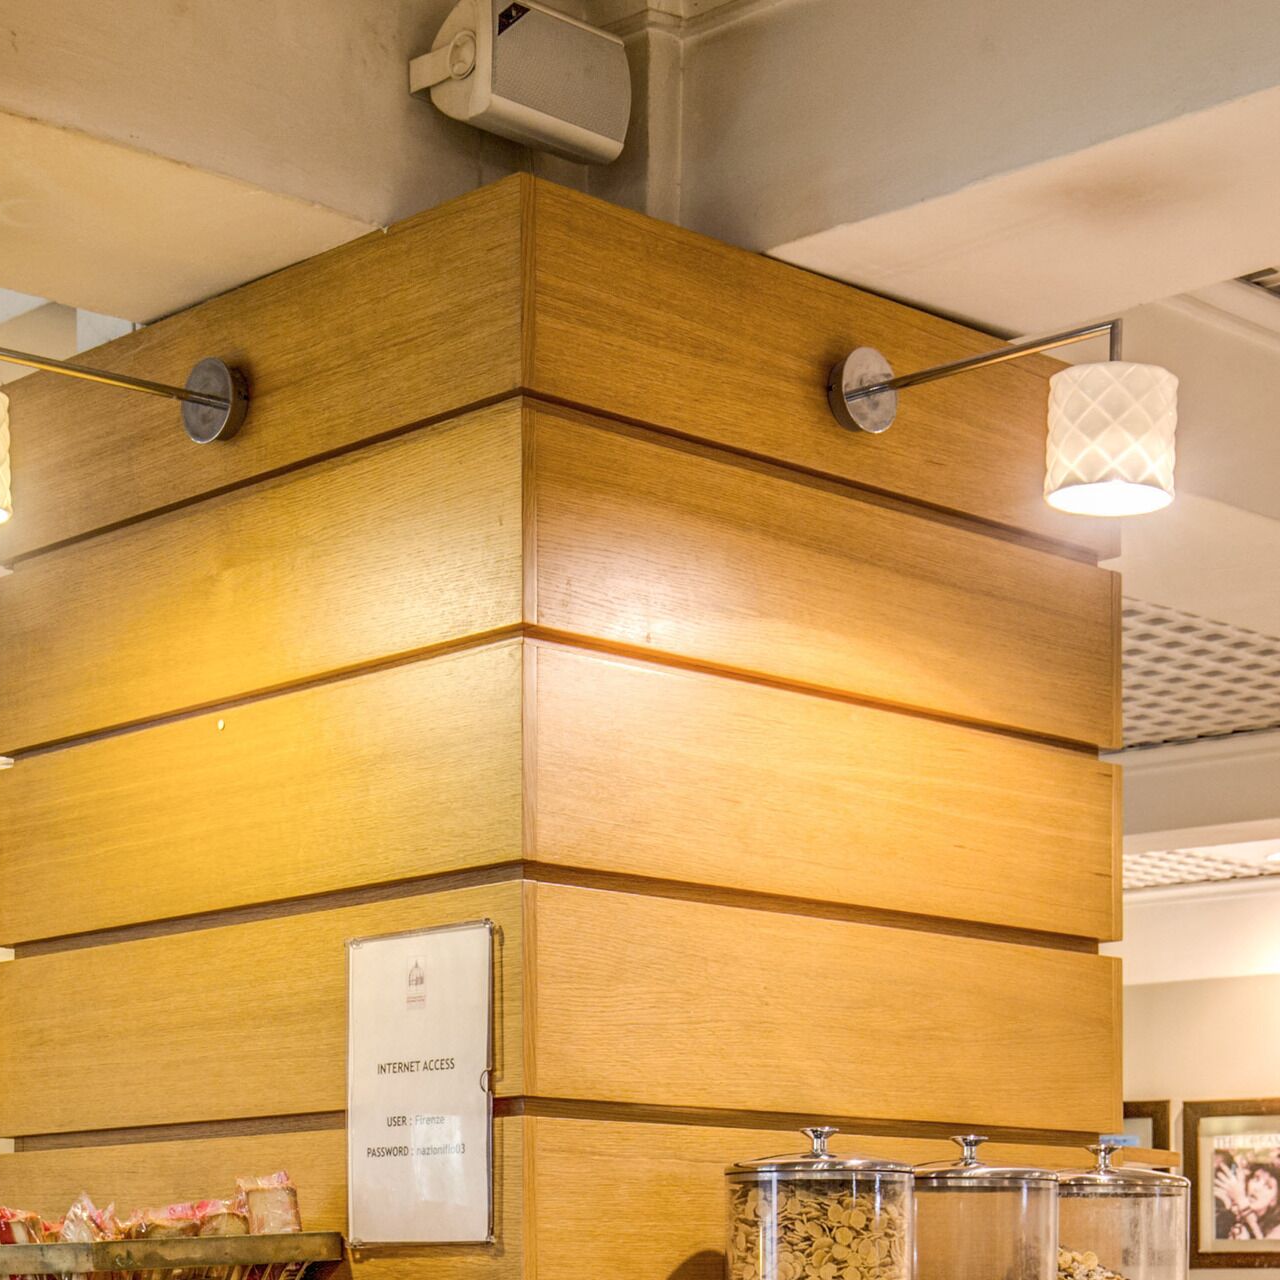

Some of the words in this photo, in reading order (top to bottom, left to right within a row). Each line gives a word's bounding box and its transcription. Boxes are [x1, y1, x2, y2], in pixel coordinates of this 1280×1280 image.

[377, 1061, 420, 1075] INTERNET
[422, 1058, 455, 1071] ACCESS
[386, 1116, 407, 1127] USER
[366, 1146, 409, 1158] PASSWORD
